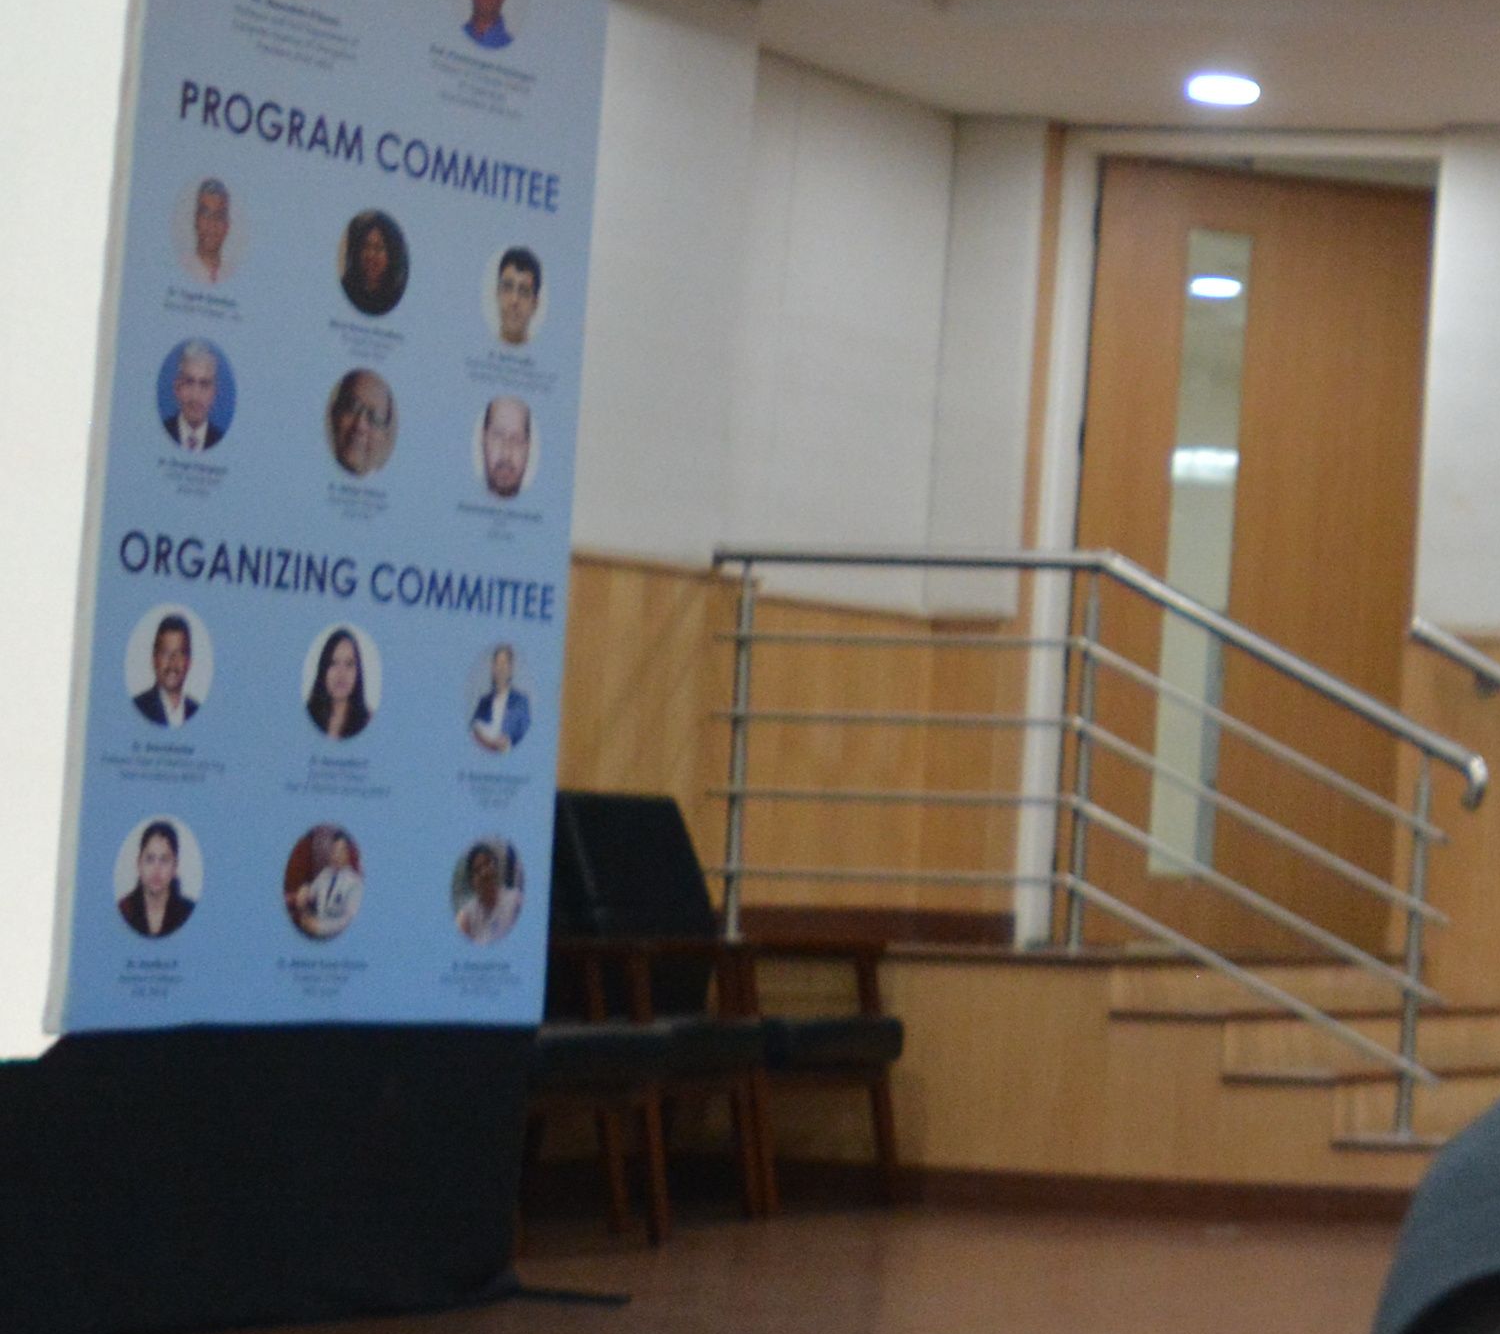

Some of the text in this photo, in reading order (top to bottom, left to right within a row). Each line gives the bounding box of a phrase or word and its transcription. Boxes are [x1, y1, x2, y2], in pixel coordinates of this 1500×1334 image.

[179, 78, 365, 166] PROGRAM
[376, 131, 561, 215] COMMITTEE
[119, 529, 557, 623] ORGANIZING COMMITTEE
